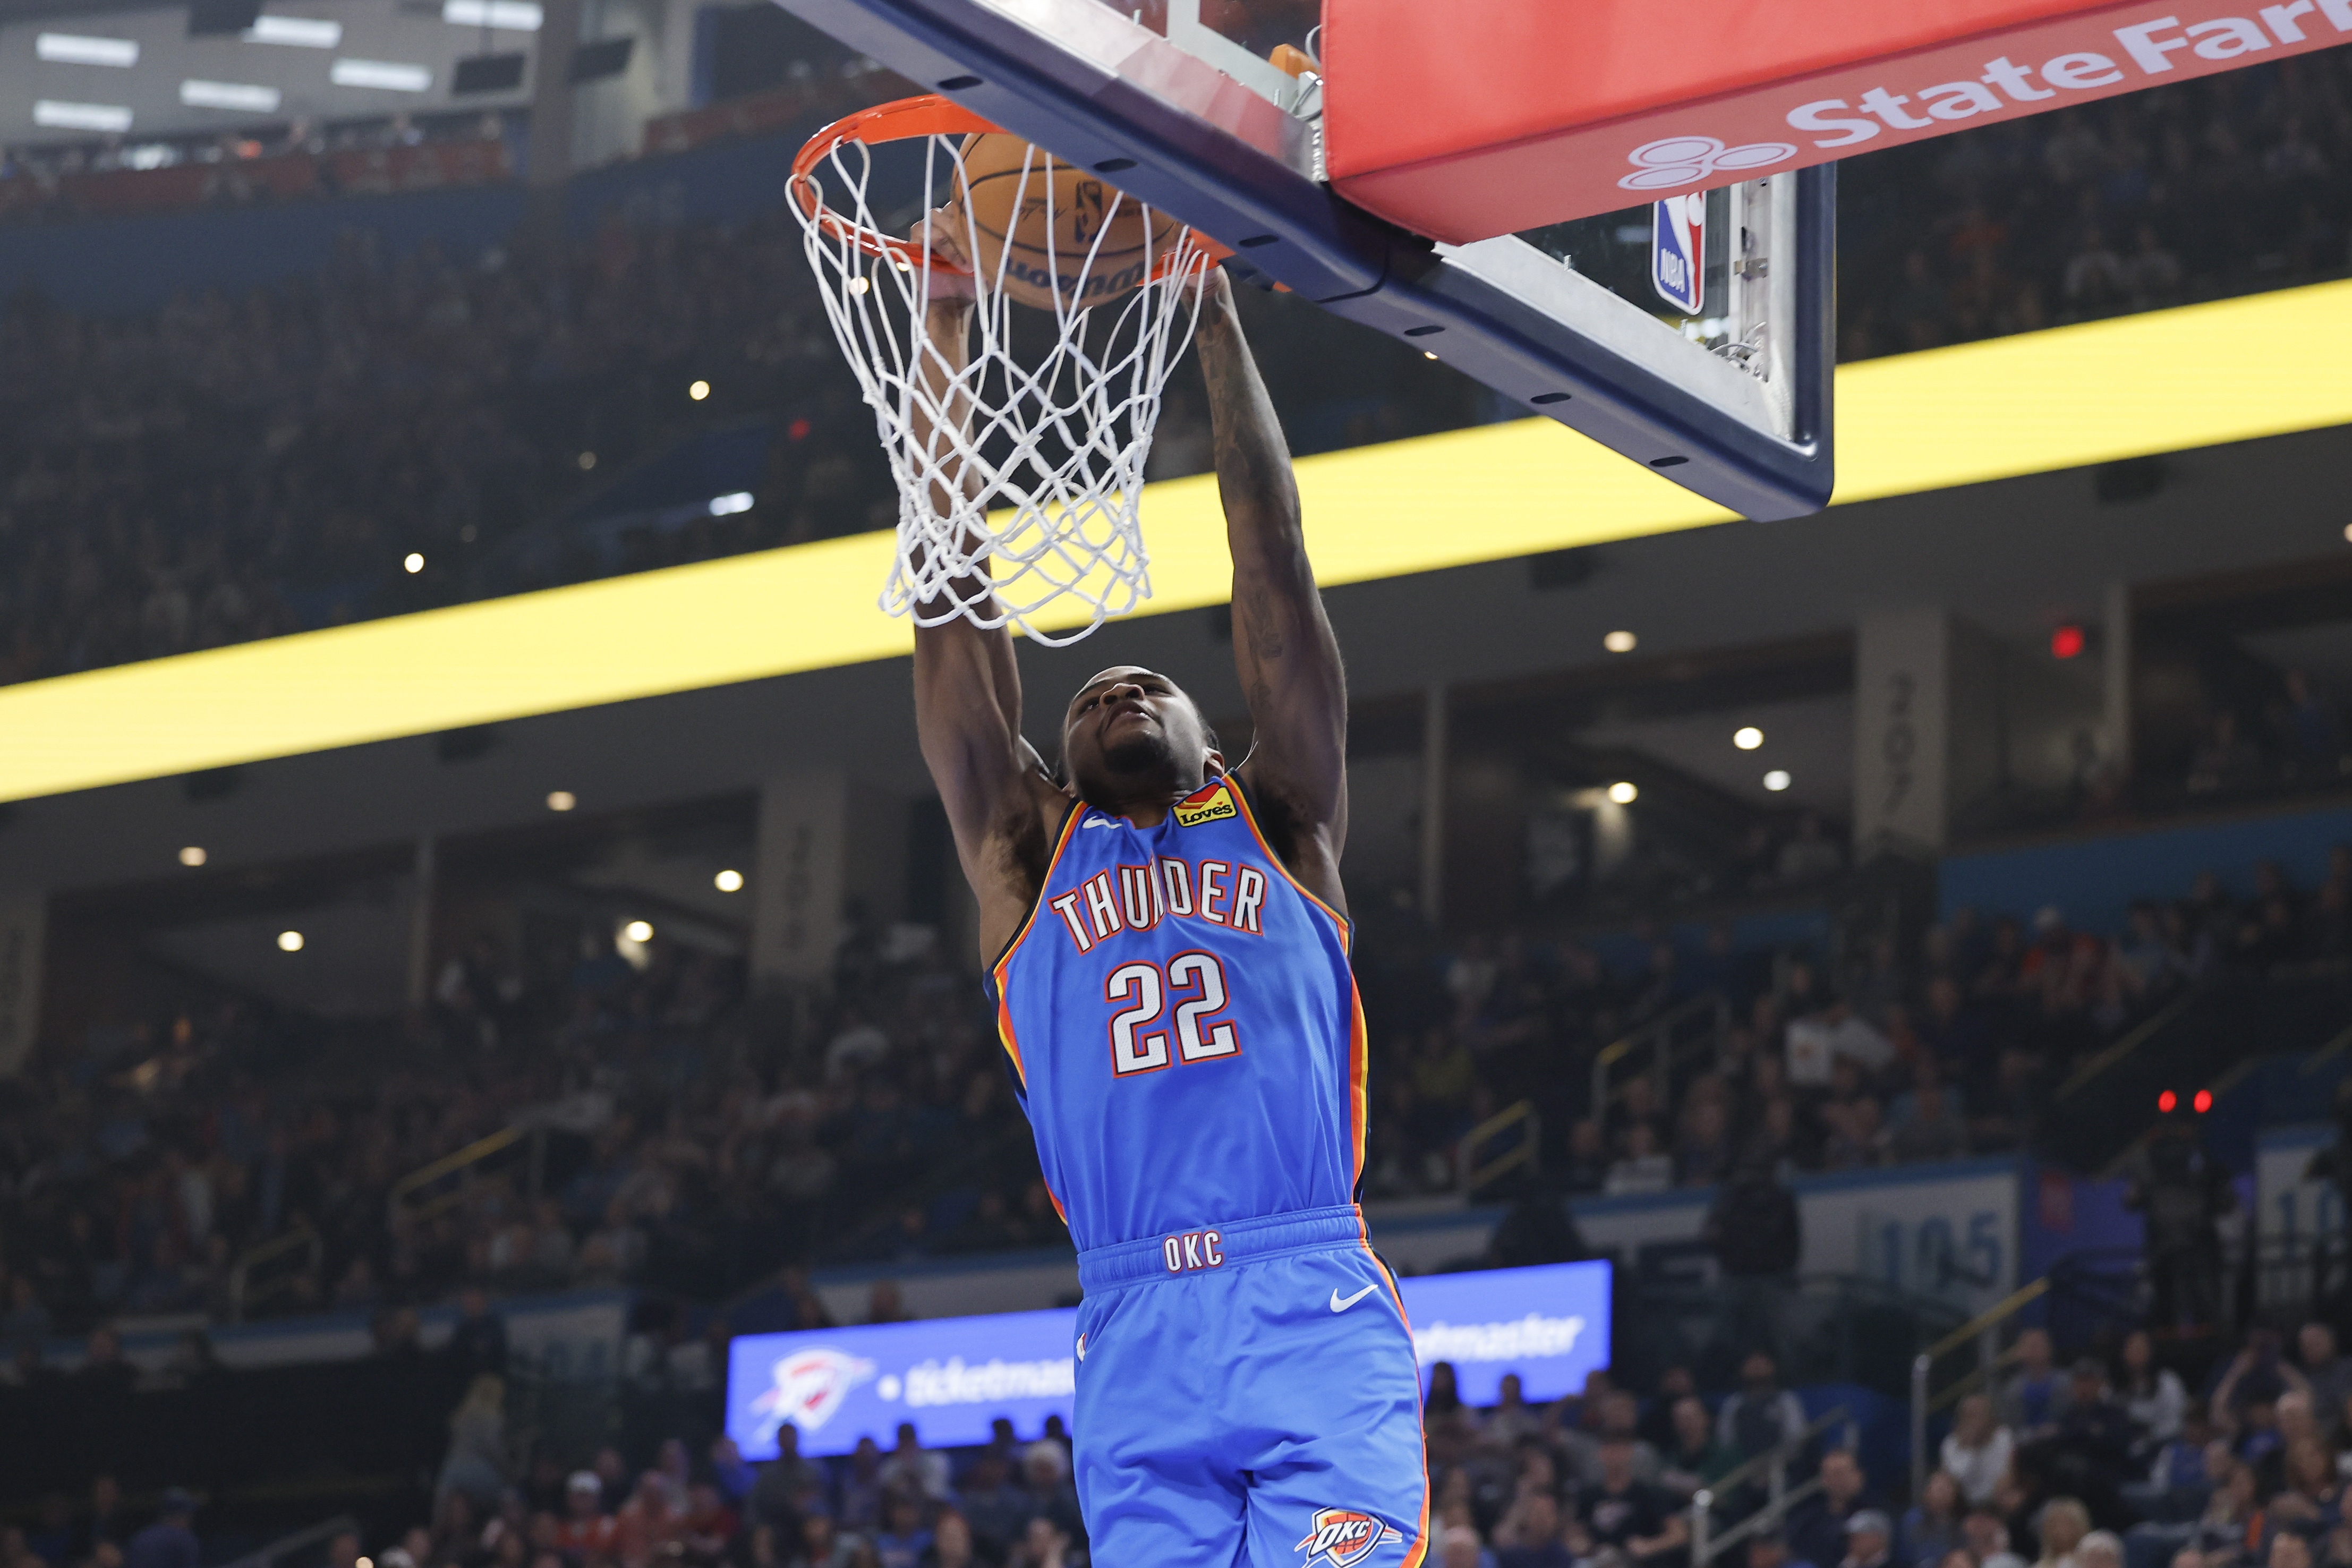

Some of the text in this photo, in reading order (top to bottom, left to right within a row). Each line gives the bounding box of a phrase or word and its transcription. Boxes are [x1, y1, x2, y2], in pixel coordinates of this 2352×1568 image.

[1786, 51, 2124, 148] State
[1659, 246, 1685, 293] NBA
[1048, 851, 1267, 956] THUNDER
[1105, 949, 1242, 1079] 22
[1163, 1230, 1225, 1273] OKC
[1309, 1520, 1371, 1557] OKC
